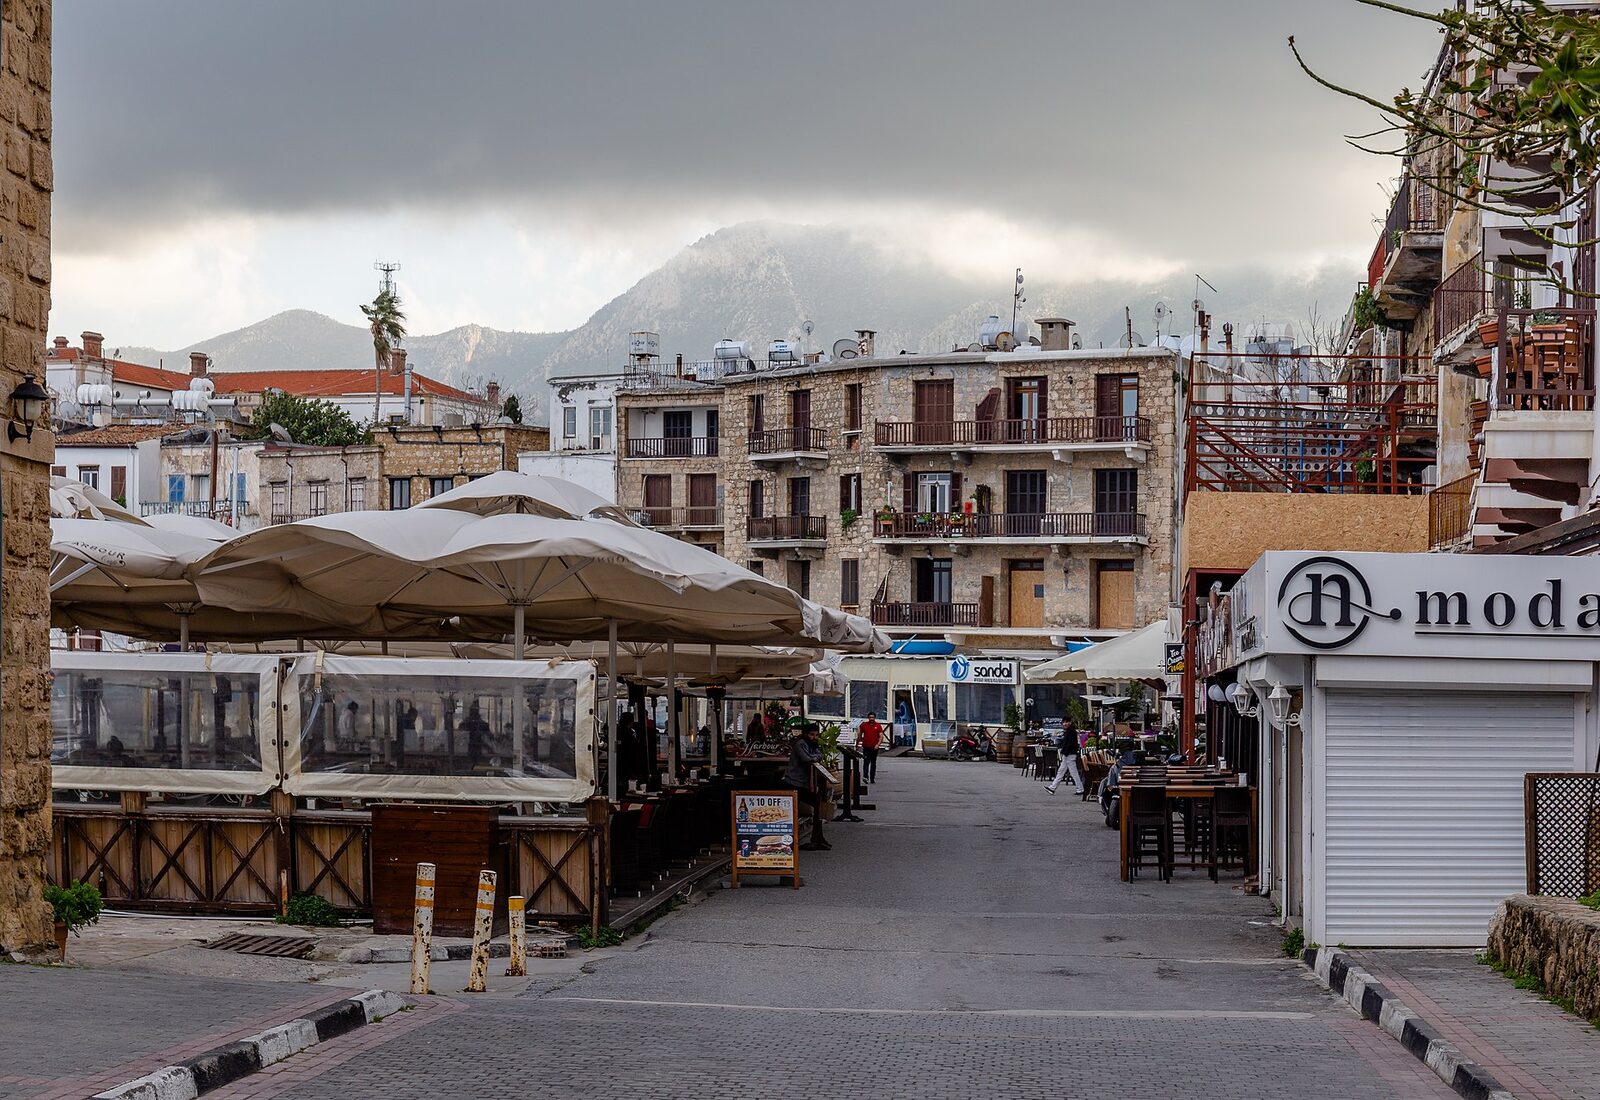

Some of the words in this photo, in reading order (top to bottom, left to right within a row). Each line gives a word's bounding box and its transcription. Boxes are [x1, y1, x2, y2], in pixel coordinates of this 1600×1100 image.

[73, 541, 126, 560] ARBOUR
[1415, 578, 1600, 629] moda
[974, 663, 1012, 678] sandal
[736, 739, 780, 757] Harbour
[757, 798, 765, 806] 10
[767, 798, 781, 806] OFF
